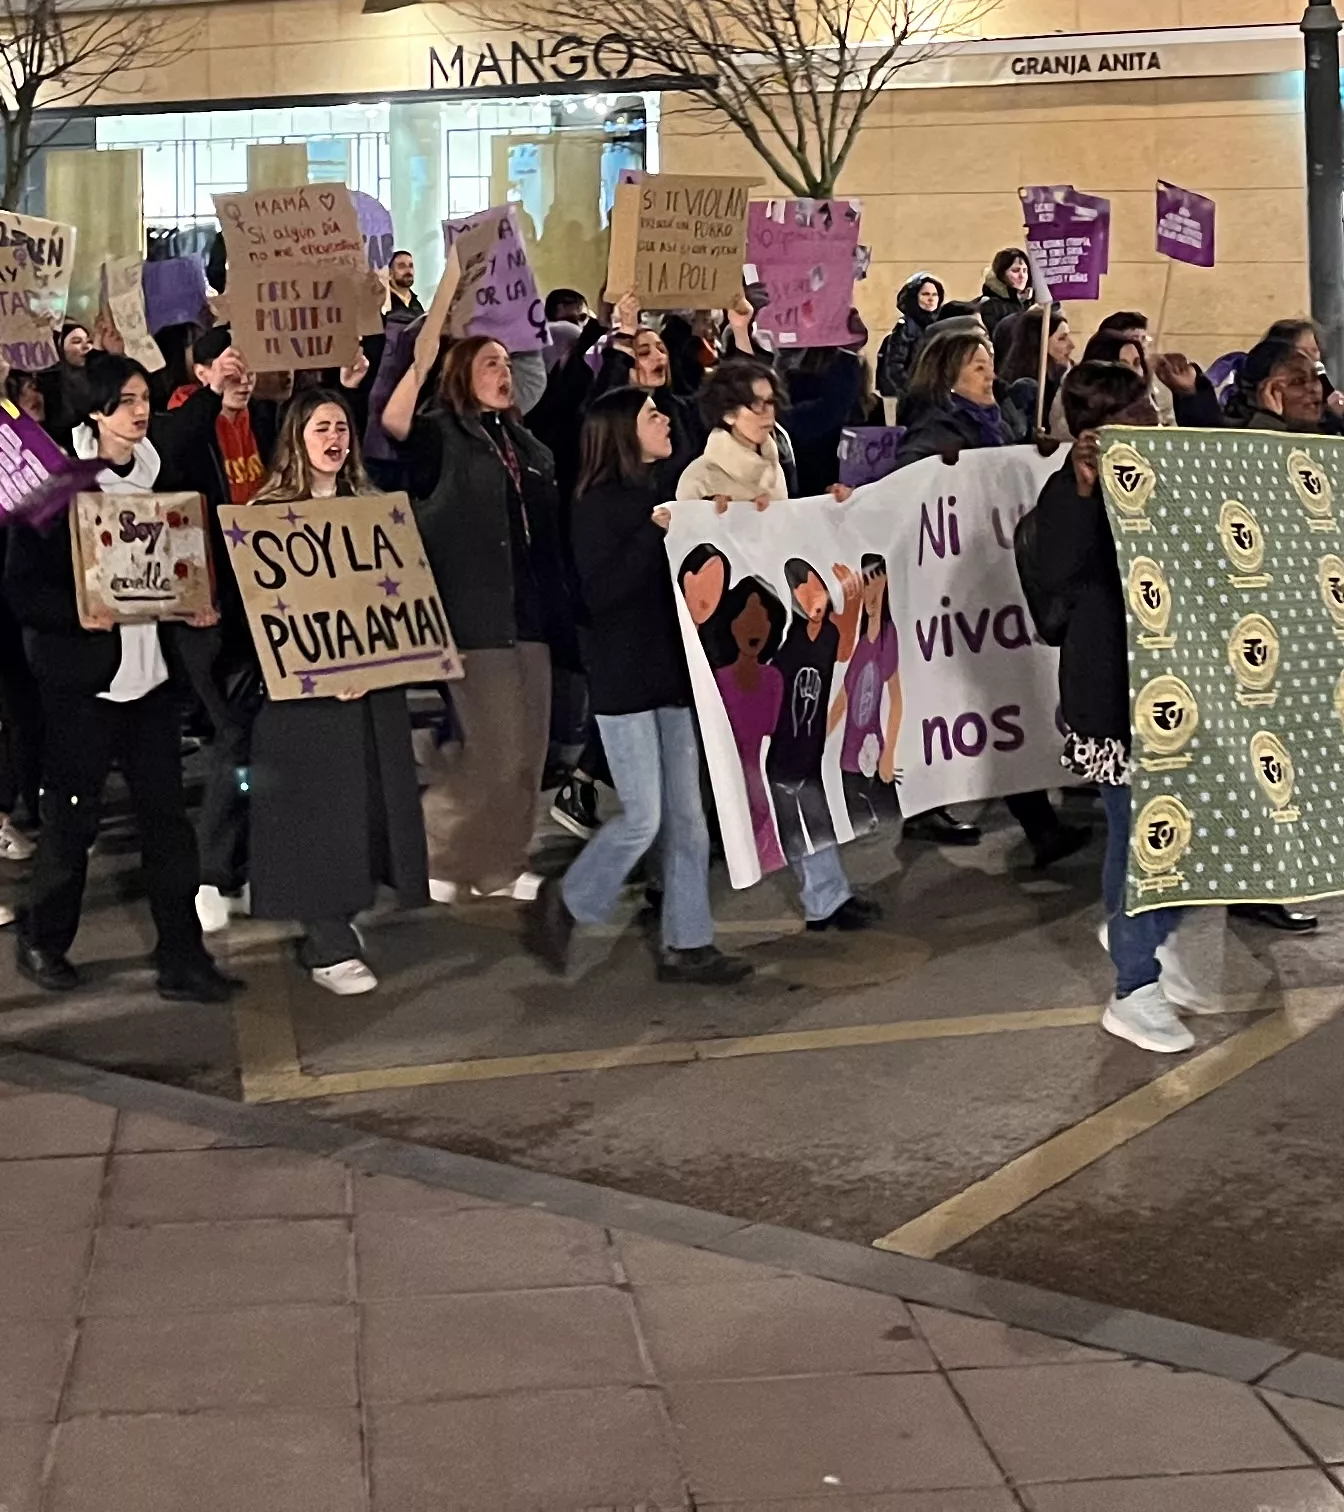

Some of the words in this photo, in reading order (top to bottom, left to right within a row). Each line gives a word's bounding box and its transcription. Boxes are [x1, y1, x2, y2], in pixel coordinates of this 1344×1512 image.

[429, 33, 635, 89] MANGO
[1011, 54, 1092, 76] GRANJA
[1098, 52, 1161, 72] ANITA
[255, 189, 311, 217] MAMÁ
[666, 190, 680, 213] TE
[685, 186, 749, 222] VIOLAN
[694, 220, 734, 239] PORRO
[249, 250, 268, 263] no
[505, 279, 528, 302] LA
[679, 262, 719, 292] POLI
[119, 510, 164, 555] Soy
[918, 495, 961, 567] Ni
[252, 521, 337, 590] SOY
[341, 524, 404, 572] LA
[260, 609, 366, 679] PUTA
[921, 704, 1025, 766] nos
